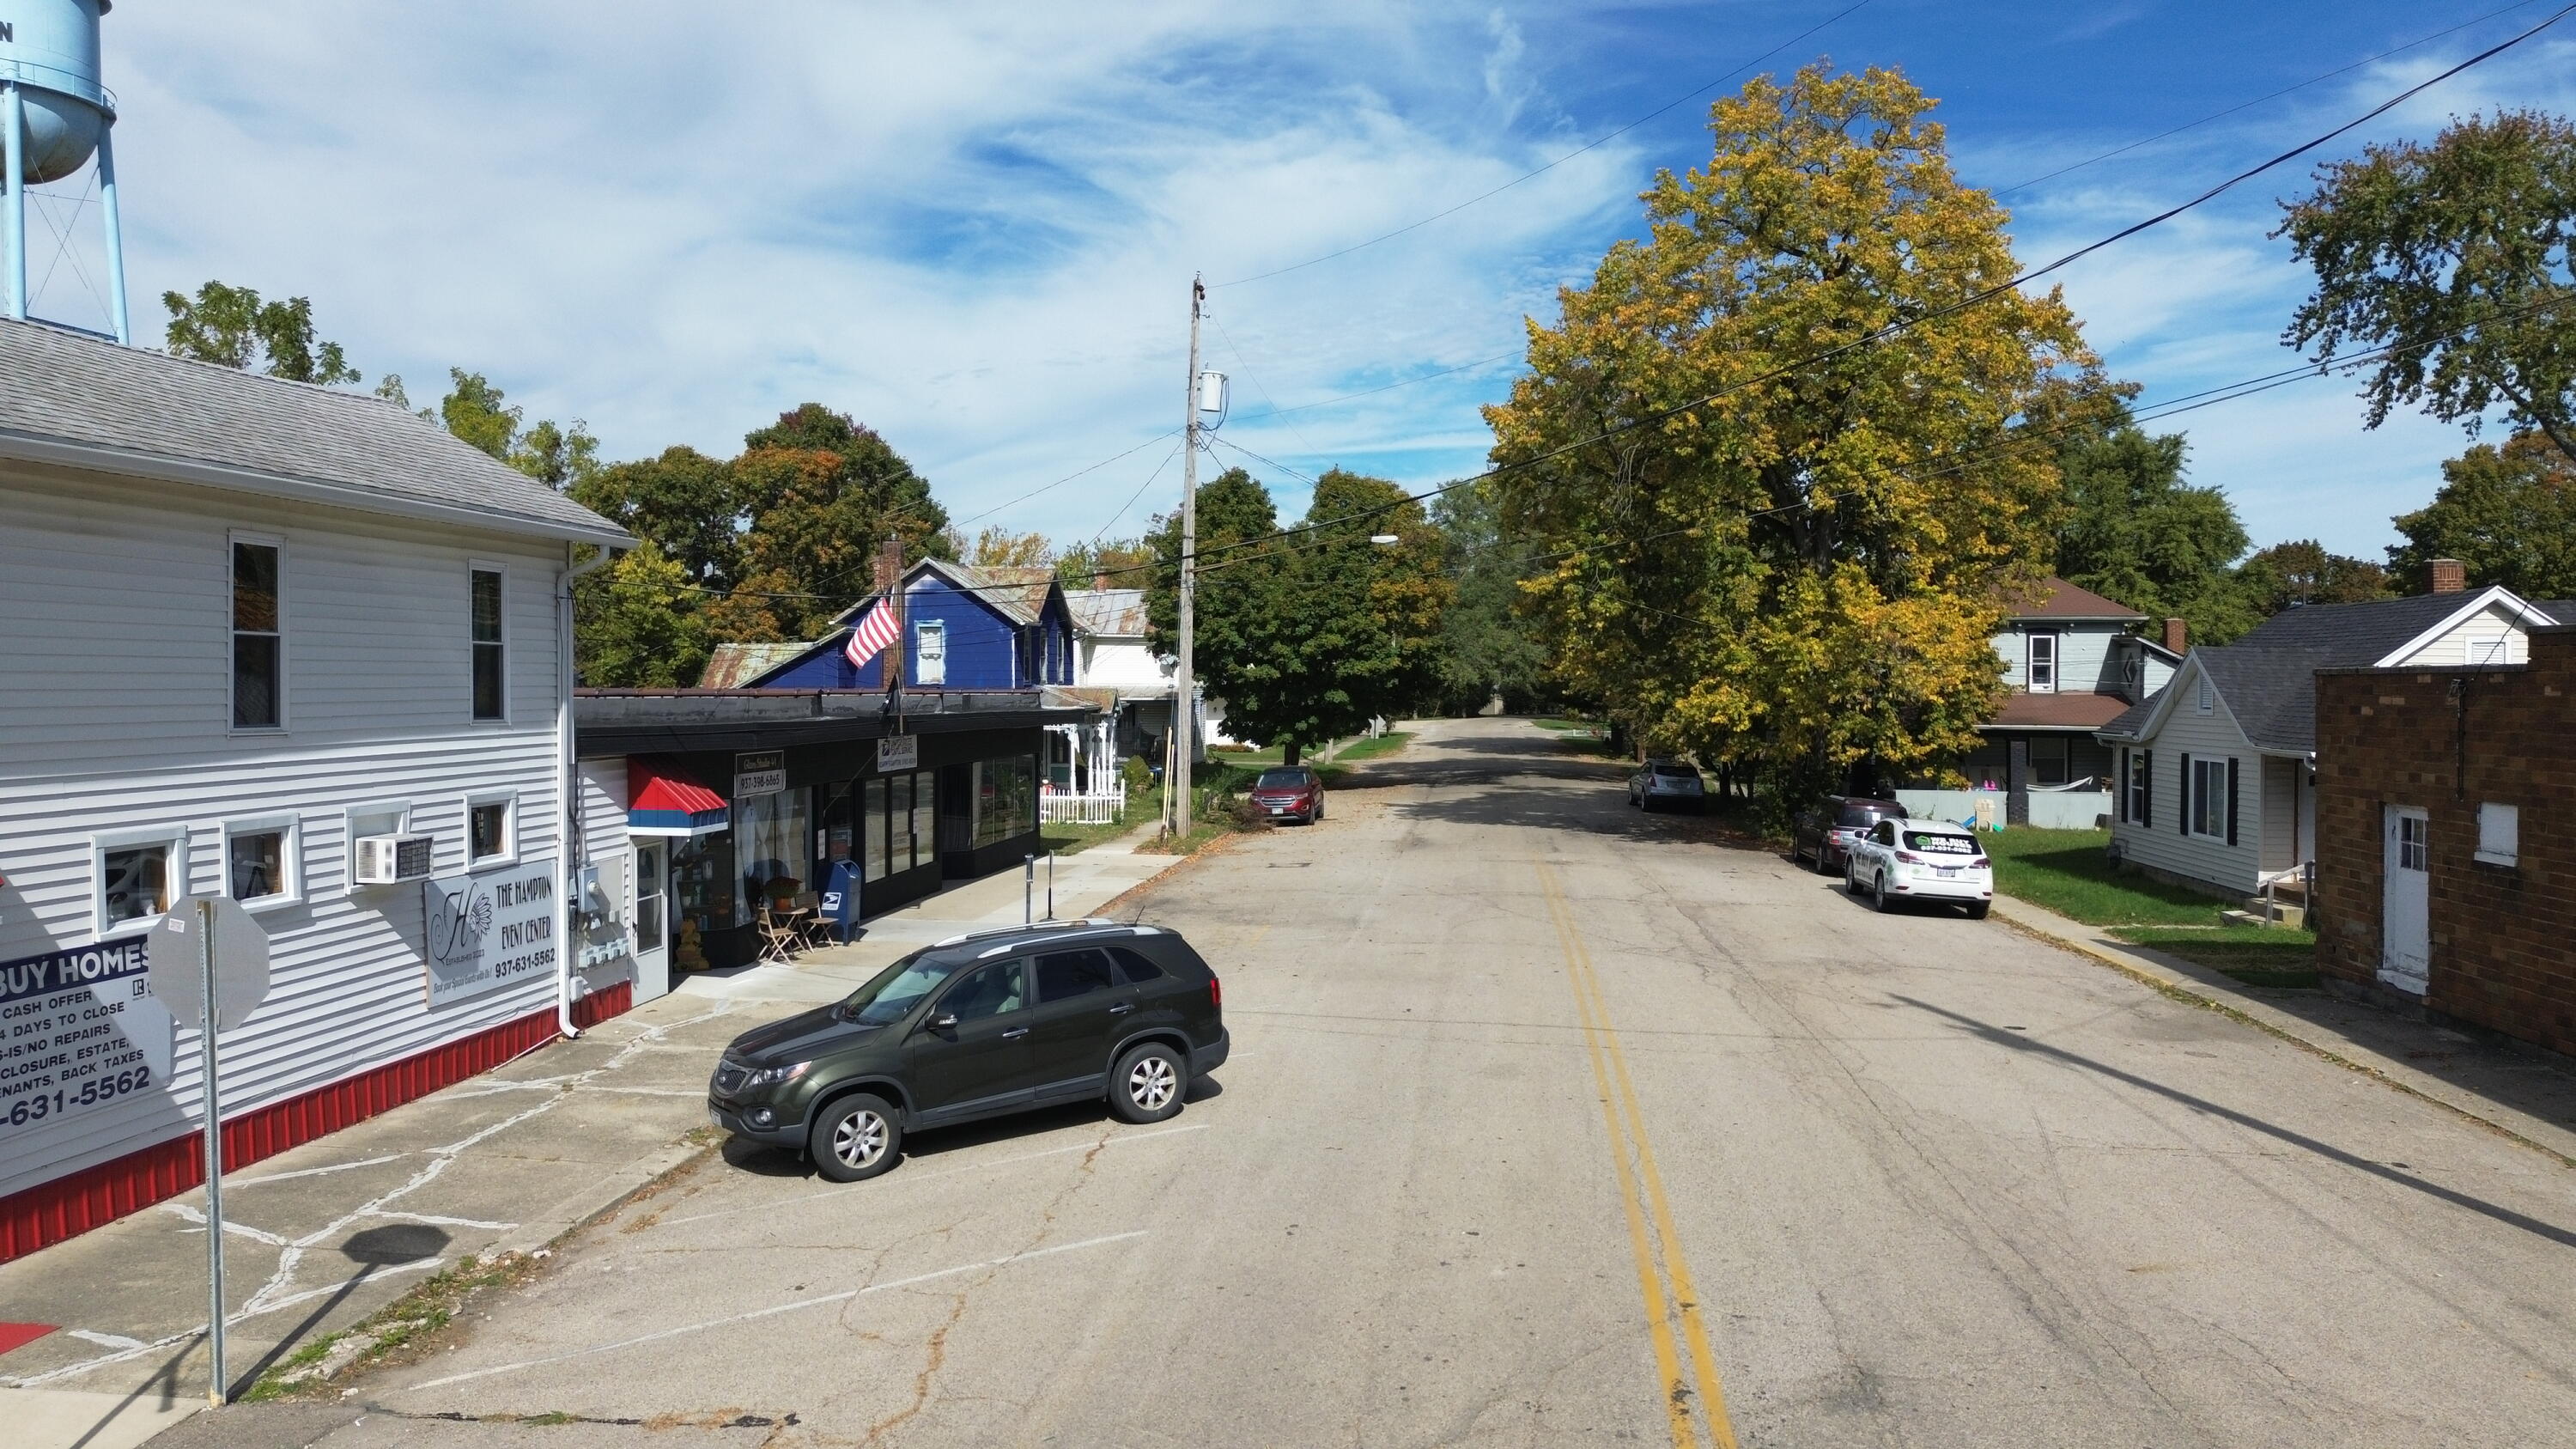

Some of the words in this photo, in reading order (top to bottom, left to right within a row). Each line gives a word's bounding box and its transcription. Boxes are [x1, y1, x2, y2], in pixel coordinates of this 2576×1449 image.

[496, 883, 513, 909] THE
[515, 874, 552, 904] HAMPTON
[501, 922, 522, 950] EVENT
[526, 916, 550, 944] CENTER
[495, 948, 556, 978] 937-631-5562
[3, 1002, 41, 1020] CASH
[48, 990, 92, 1009] OFFER
[14, 1019, 52, 1038] DAYS
[58, 1014, 76, 1026] TO
[82, 1002, 125, 1020] CLOSE
[55, 1024, 111, 1047] REPAIRS
[0, 1075, 54, 1098] NANTS,
[61, 1062, 97, 1081] BACK
[104, 1049, 144, 1069] TAXES
[1, 1053, 70, 1080] CLOSURE,
[77, 1038, 129, 1060] ESTATE,
[0, 1065, 150, 1126] -631-5562
